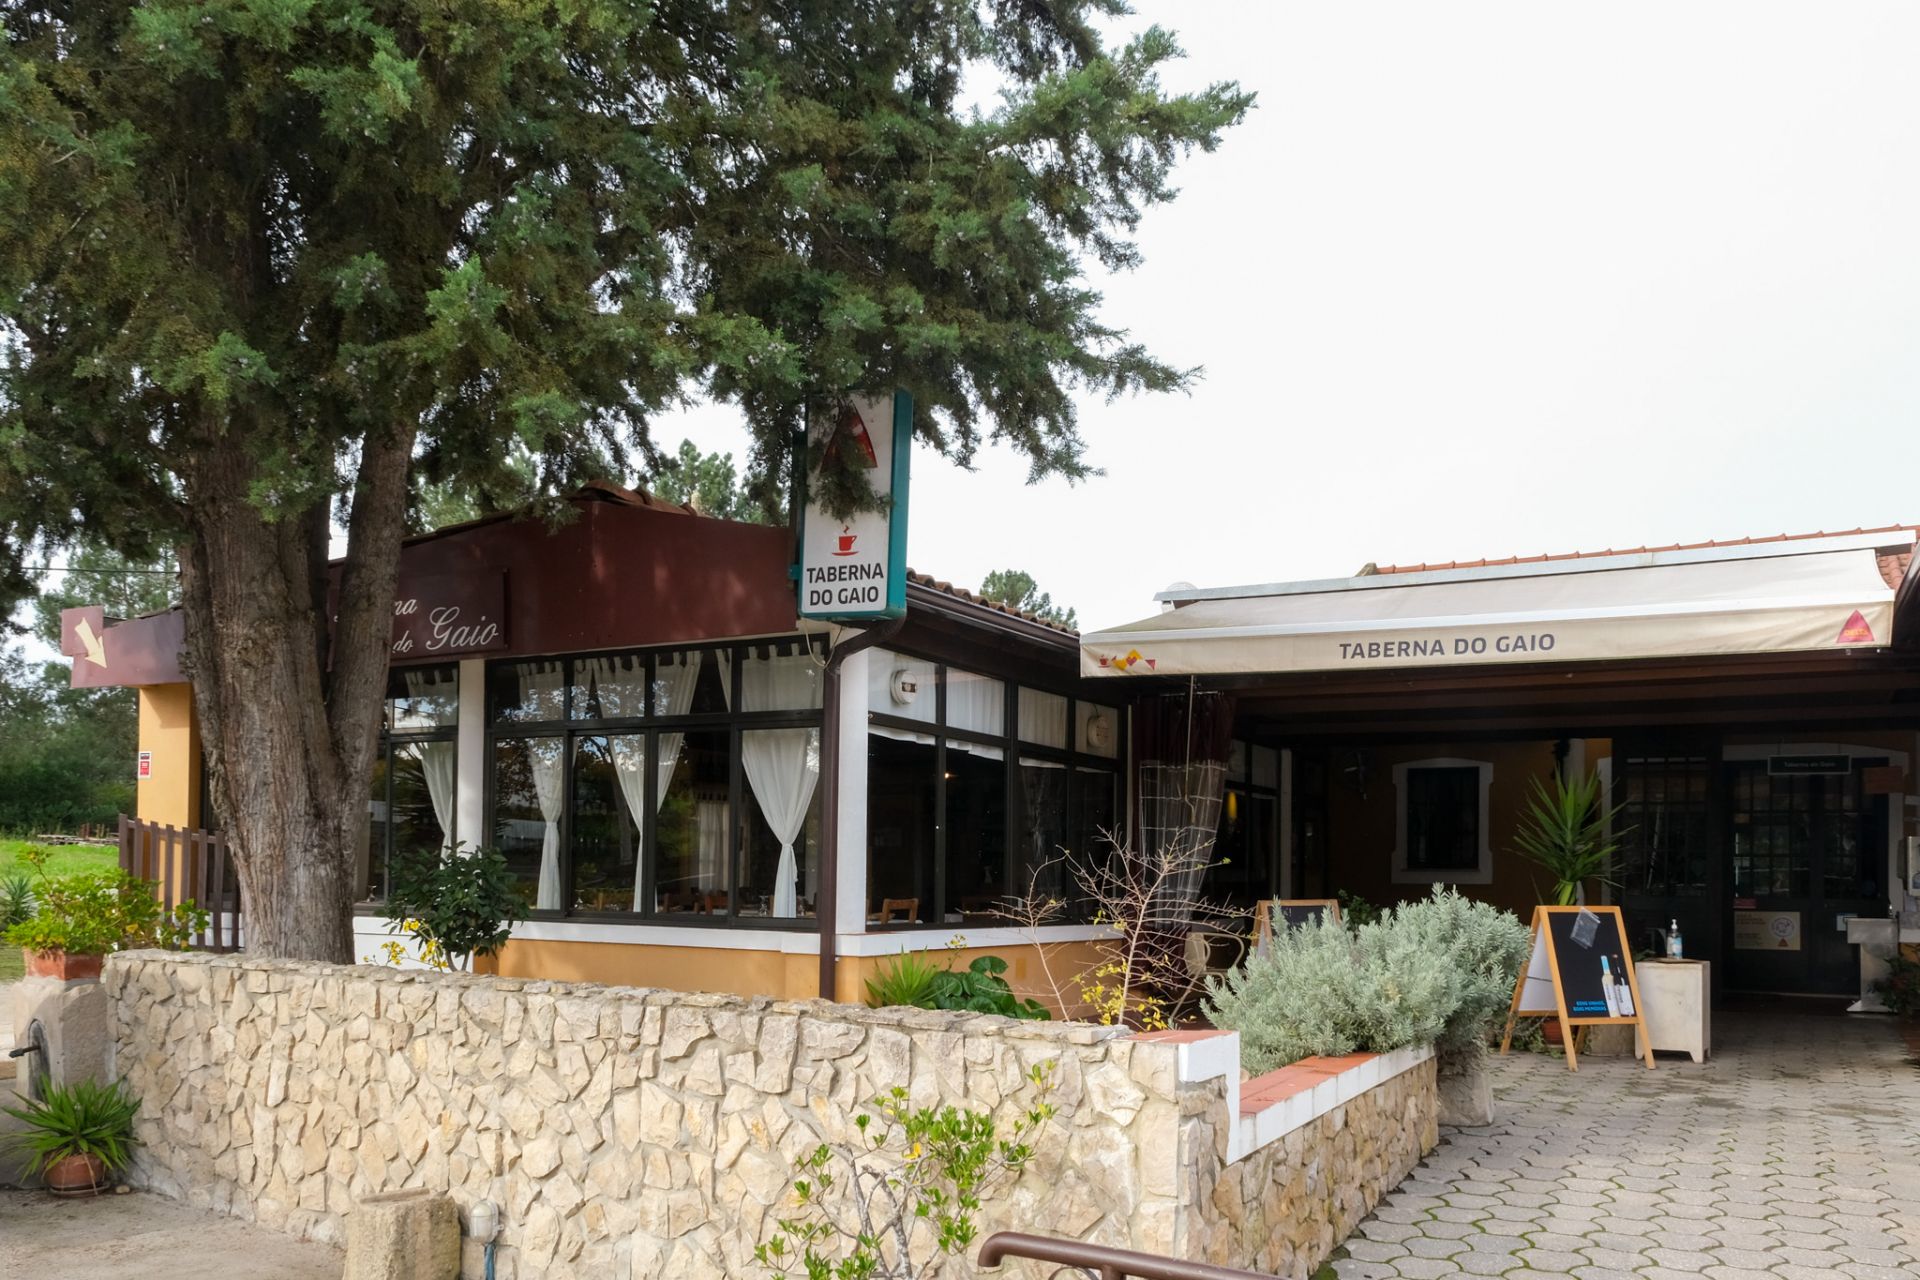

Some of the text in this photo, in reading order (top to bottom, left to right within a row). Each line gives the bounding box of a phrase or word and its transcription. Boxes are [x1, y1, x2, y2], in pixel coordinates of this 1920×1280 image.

[806, 563, 884, 584] TABERNA
[810, 586, 879, 606] DO GAIO
[426, 606, 499, 650] Gaio
[1339, 633, 1555, 660] TABERNA DO GAIO
